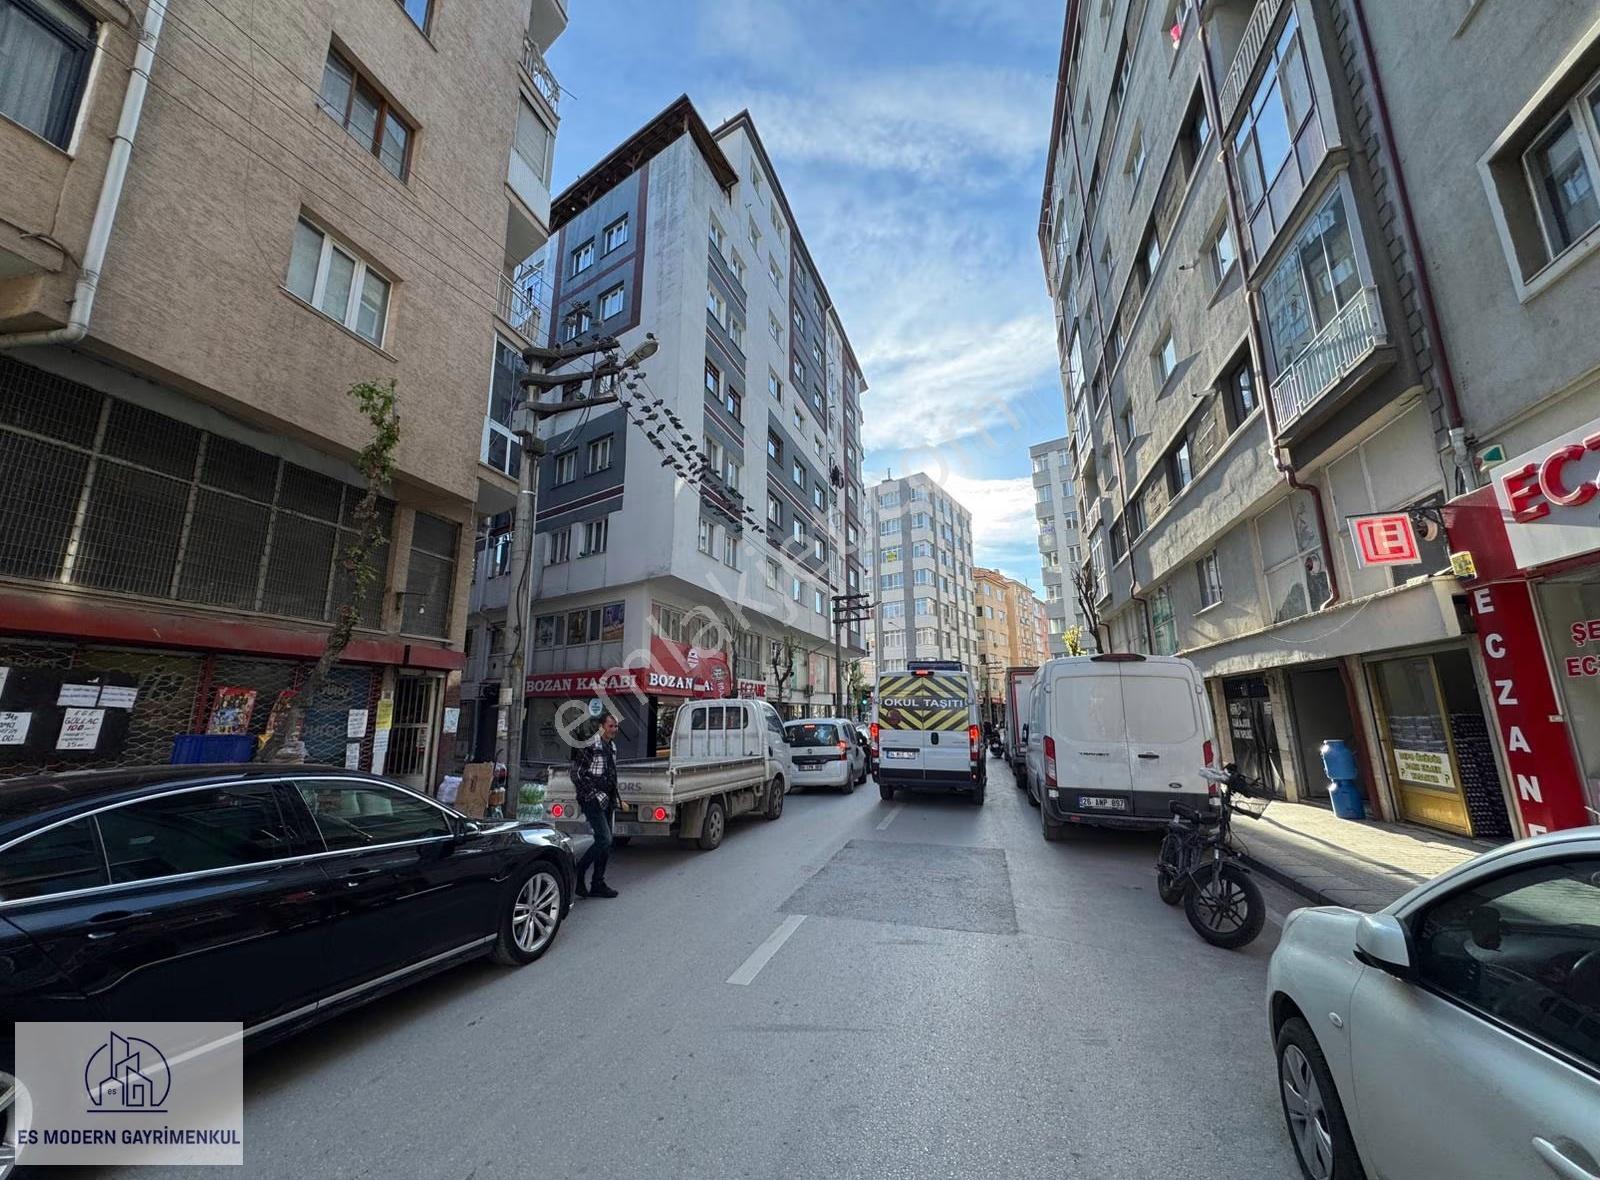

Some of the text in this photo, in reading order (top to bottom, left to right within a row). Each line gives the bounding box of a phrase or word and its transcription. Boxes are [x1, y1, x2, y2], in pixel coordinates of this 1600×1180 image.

[1566, 655, 1600, 677] EC
[526, 675, 637, 692] BOZAN KASABI
[649, 673, 693, 689] BOZAN
[884, 698, 964, 708] OKUL TAŞITI
